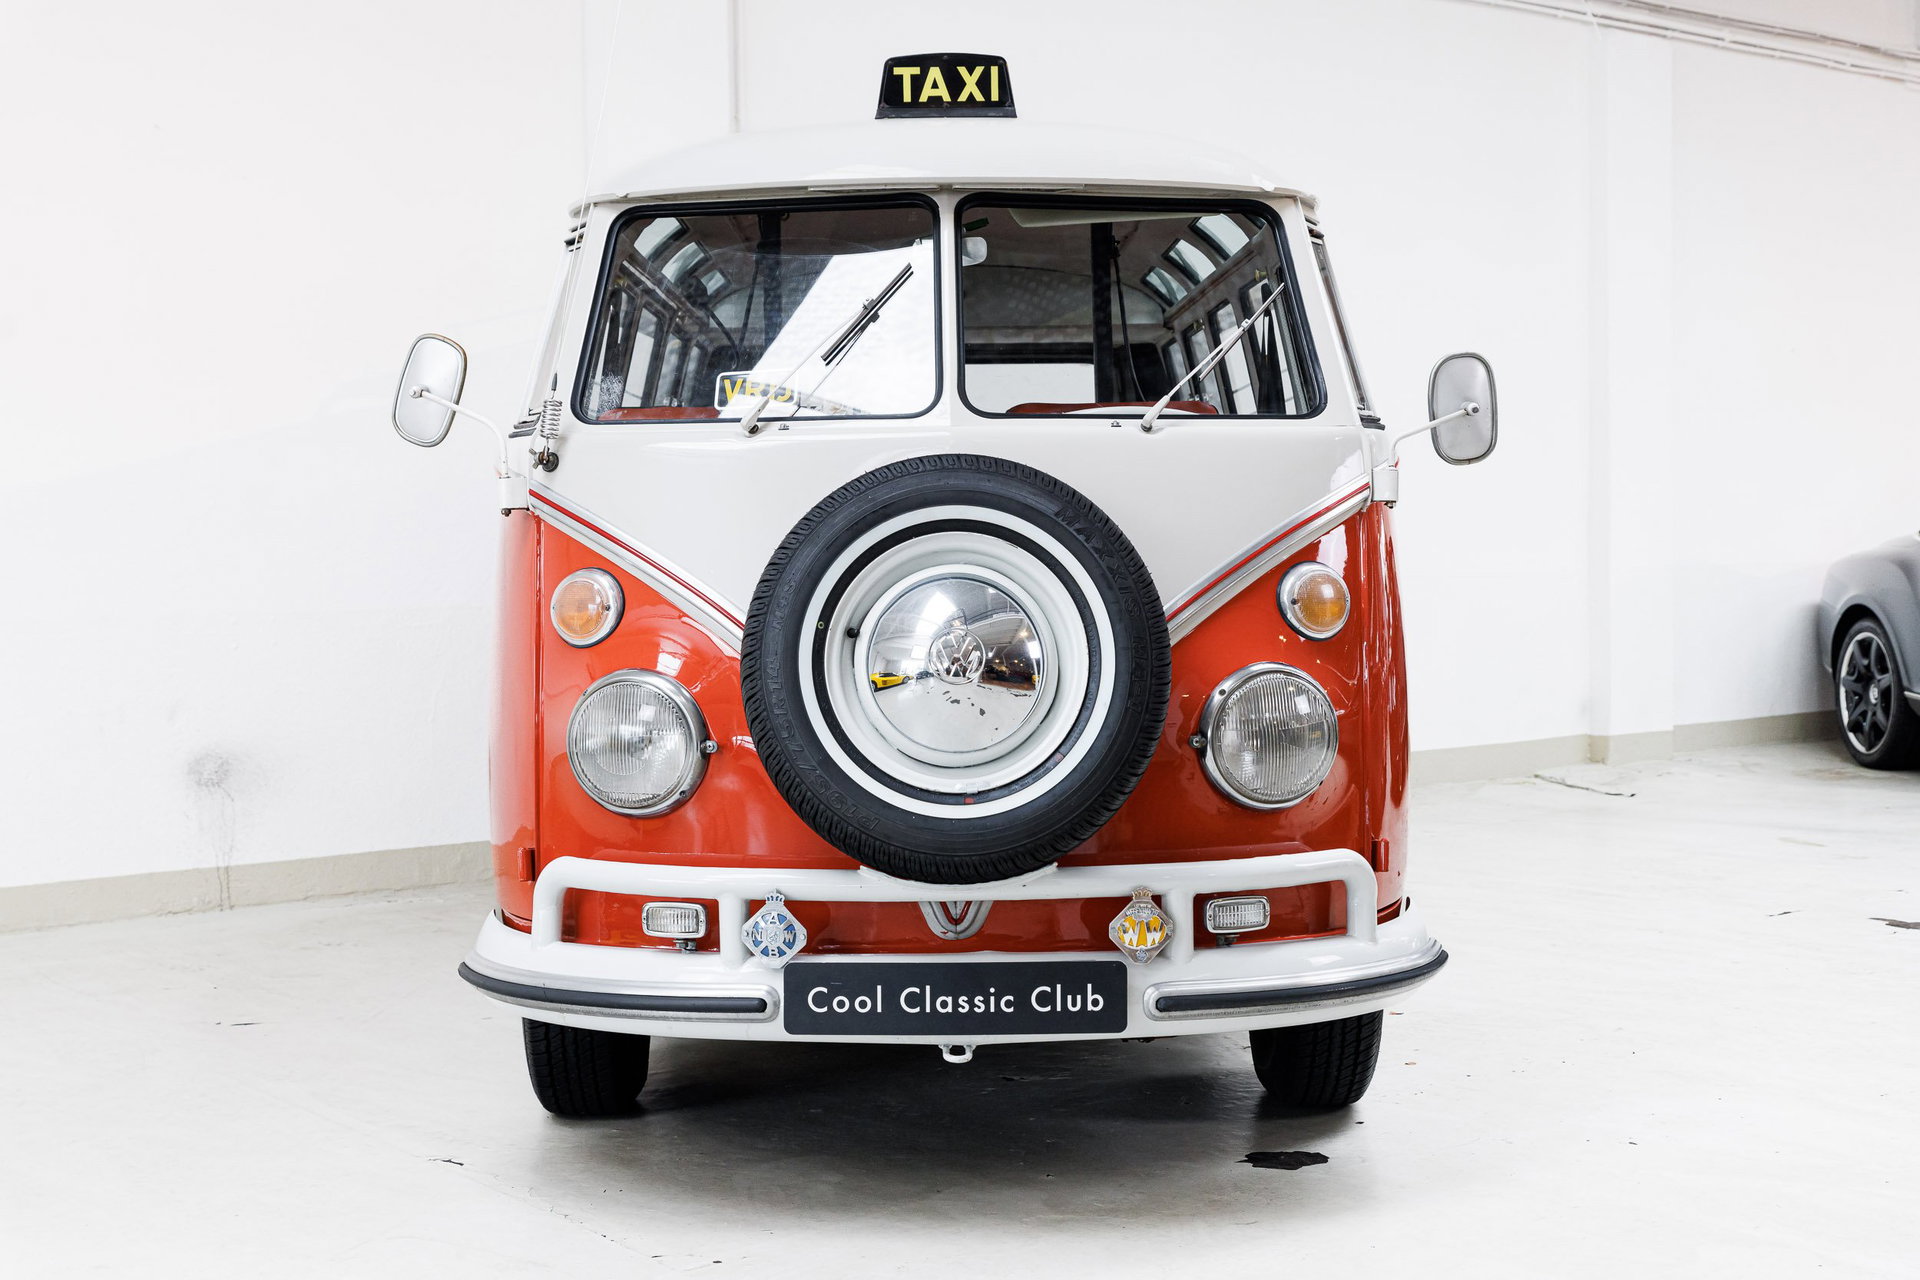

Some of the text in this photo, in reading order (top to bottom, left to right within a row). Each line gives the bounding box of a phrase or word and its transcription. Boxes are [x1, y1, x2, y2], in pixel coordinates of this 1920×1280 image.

[893, 66, 999, 103] TAXI
[1054, 507, 1141, 617] MAXXIS
[930, 628, 985, 684] VW
[807, 983, 1105, 1014] Cool Classic Club
